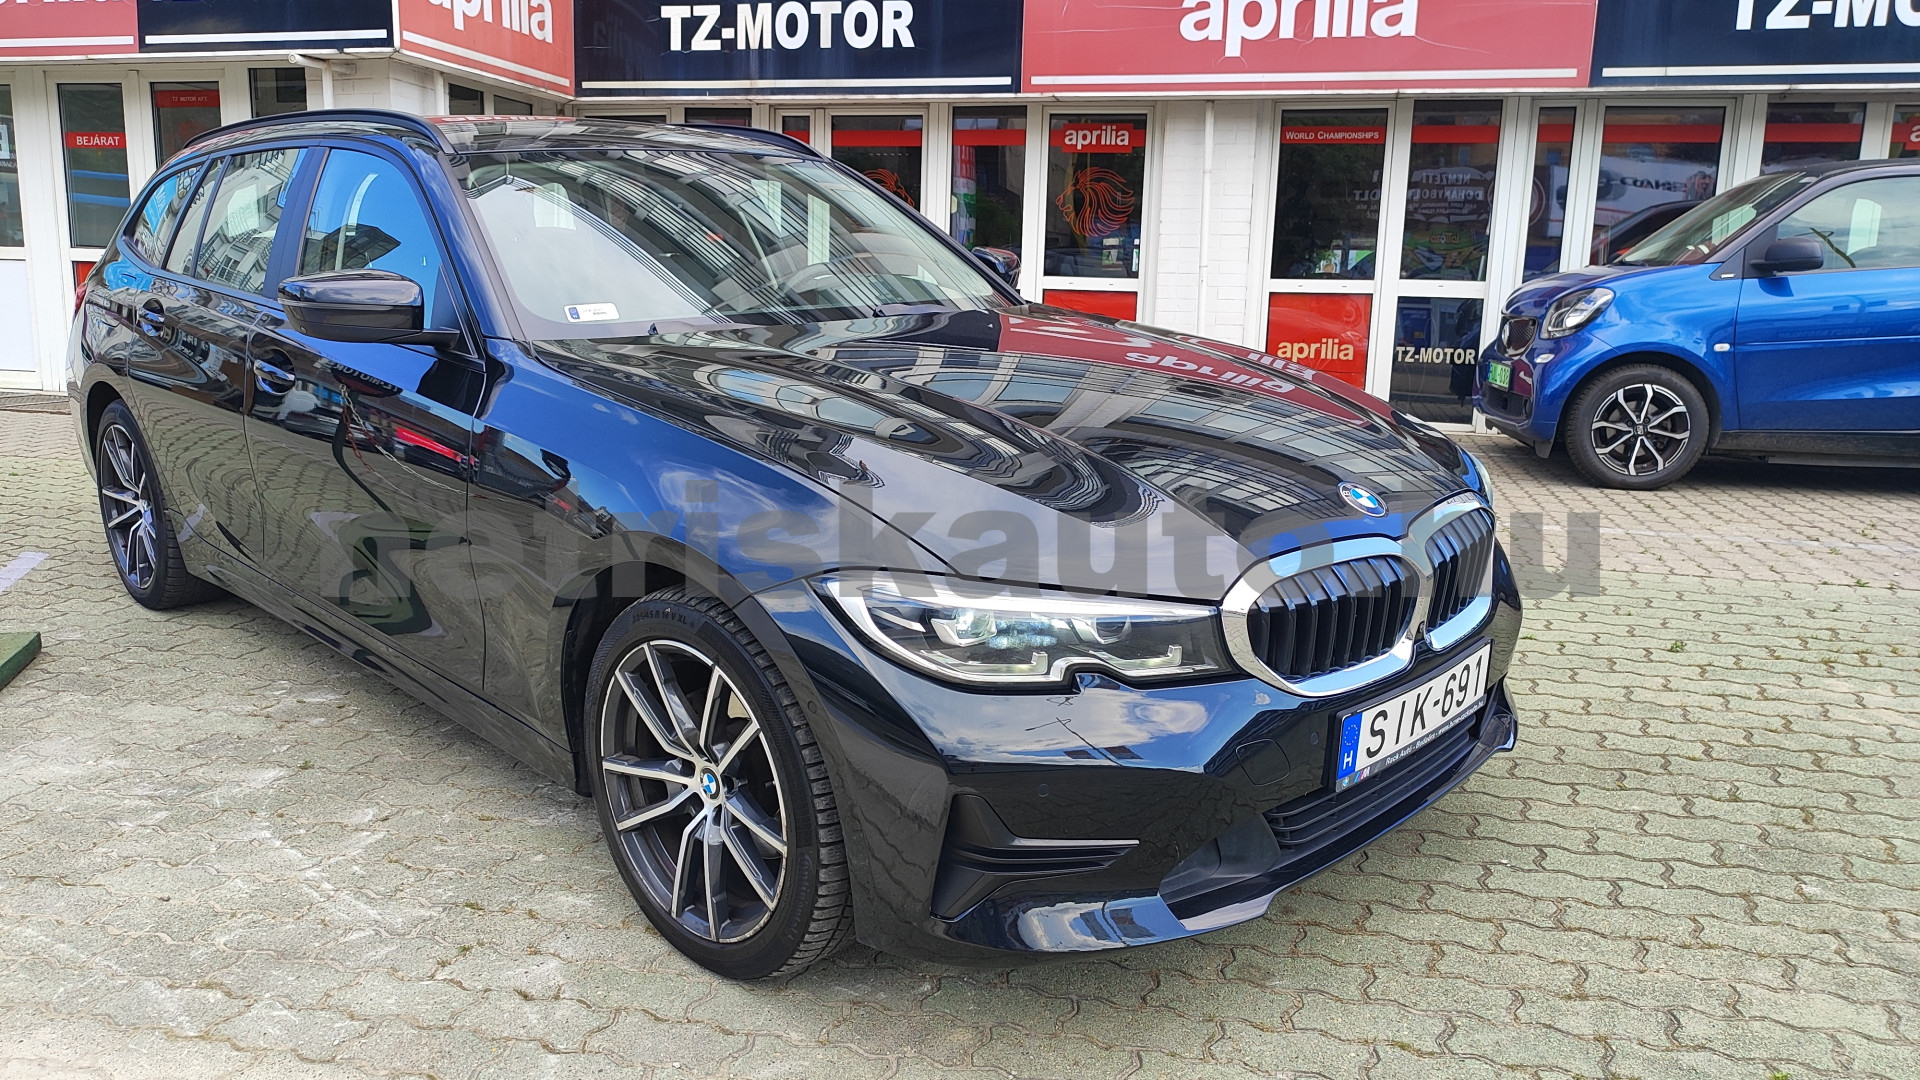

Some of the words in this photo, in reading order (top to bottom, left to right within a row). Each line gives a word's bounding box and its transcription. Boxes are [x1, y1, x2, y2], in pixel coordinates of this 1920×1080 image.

[660, 0, 915, 51] TZ-MOTOR
[76, 133, 120, 147] BEJÁRAT
[1064, 125, 1129, 150] aprilia
[1285, 131, 1315, 140] WORLD
[1317, 131, 1380, 140] CHAMPIONSHIPS
[1277, 337, 1354, 363] aprilia
[1396, 346, 1476, 365] TZ-MOTOR
[1366, 654, 1483, 759] SIK-691
[1342, 749, 1354, 770] H
